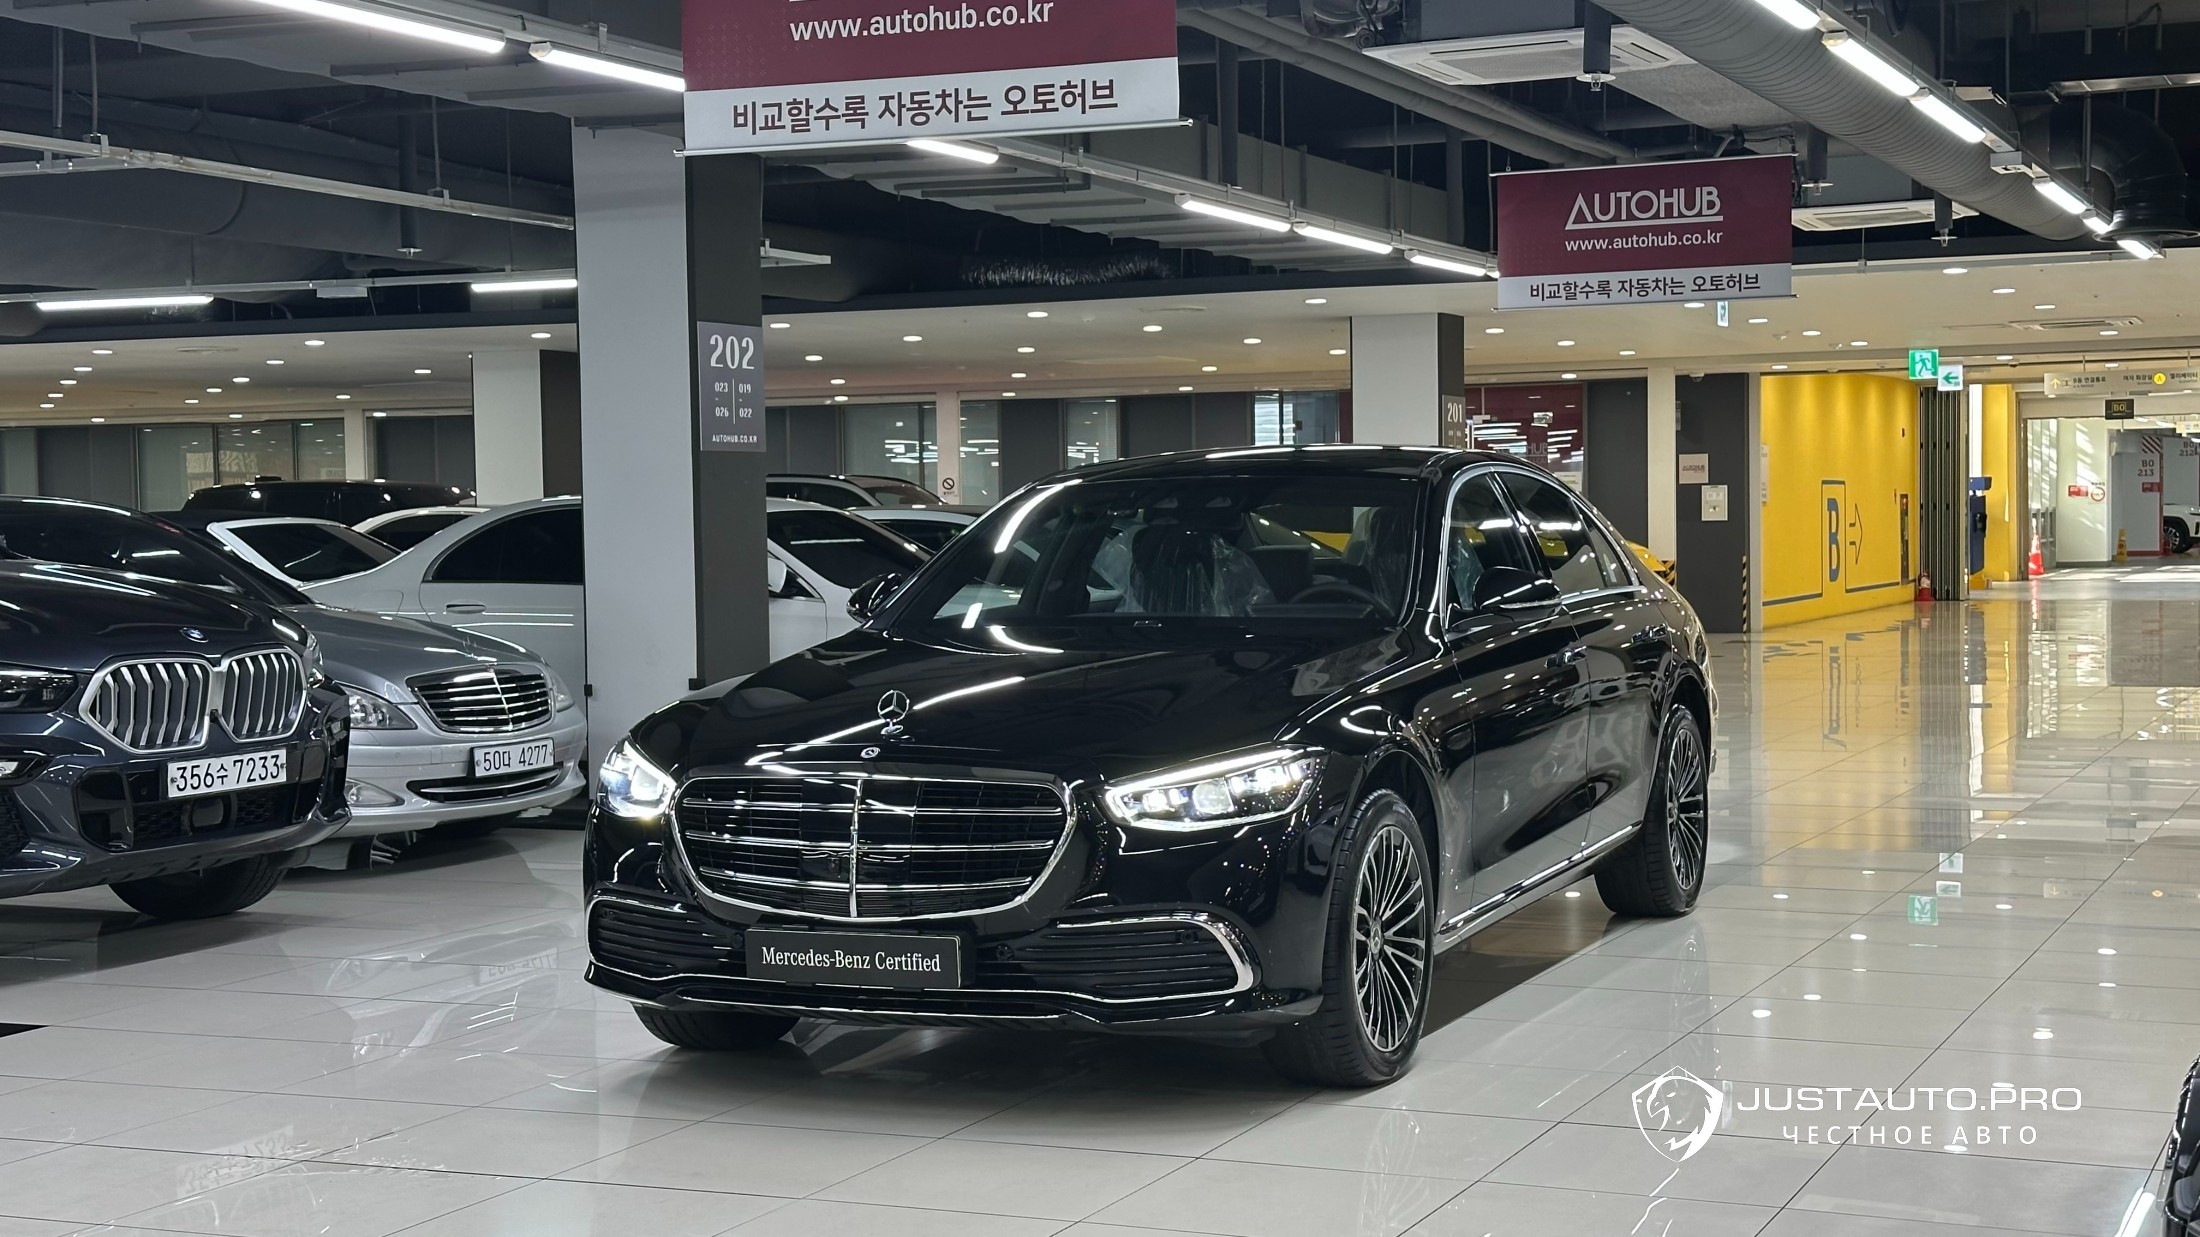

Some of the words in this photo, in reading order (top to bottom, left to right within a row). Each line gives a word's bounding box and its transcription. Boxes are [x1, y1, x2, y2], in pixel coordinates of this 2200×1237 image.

[789, 0, 1054, 42] www.autohub.co.kr
[732, 93, 869, 136] 비교할수록
[877, 87, 991, 127] 자동차는
[1000, 79, 1118, 114] 오토허브
[1565, 186, 1724, 230] AUTOHUB
[1565, 229, 1723, 252] www.autohub.co.kr
[1530, 278, 1612, 302] 비교할수록
[1617, 275, 1686, 298] 자동차는
[1691, 273, 1761, 293] 오토허브
[709, 334, 755, 370] 202
[714, 382, 729, 393] 023
[738, 383, 752, 394] 019
[739, 408, 753, 418] 022
[1447, 402, 1463, 423] 201
[1827, 497, 1841, 583] B
[518, 744, 548, 768] 4277
[176, 763, 229, 792] 356수
[233, 754, 280, 784] 7233
[761, 946, 871, 970] Mercedes-Benz
[875, 951, 941, 972] Certified
